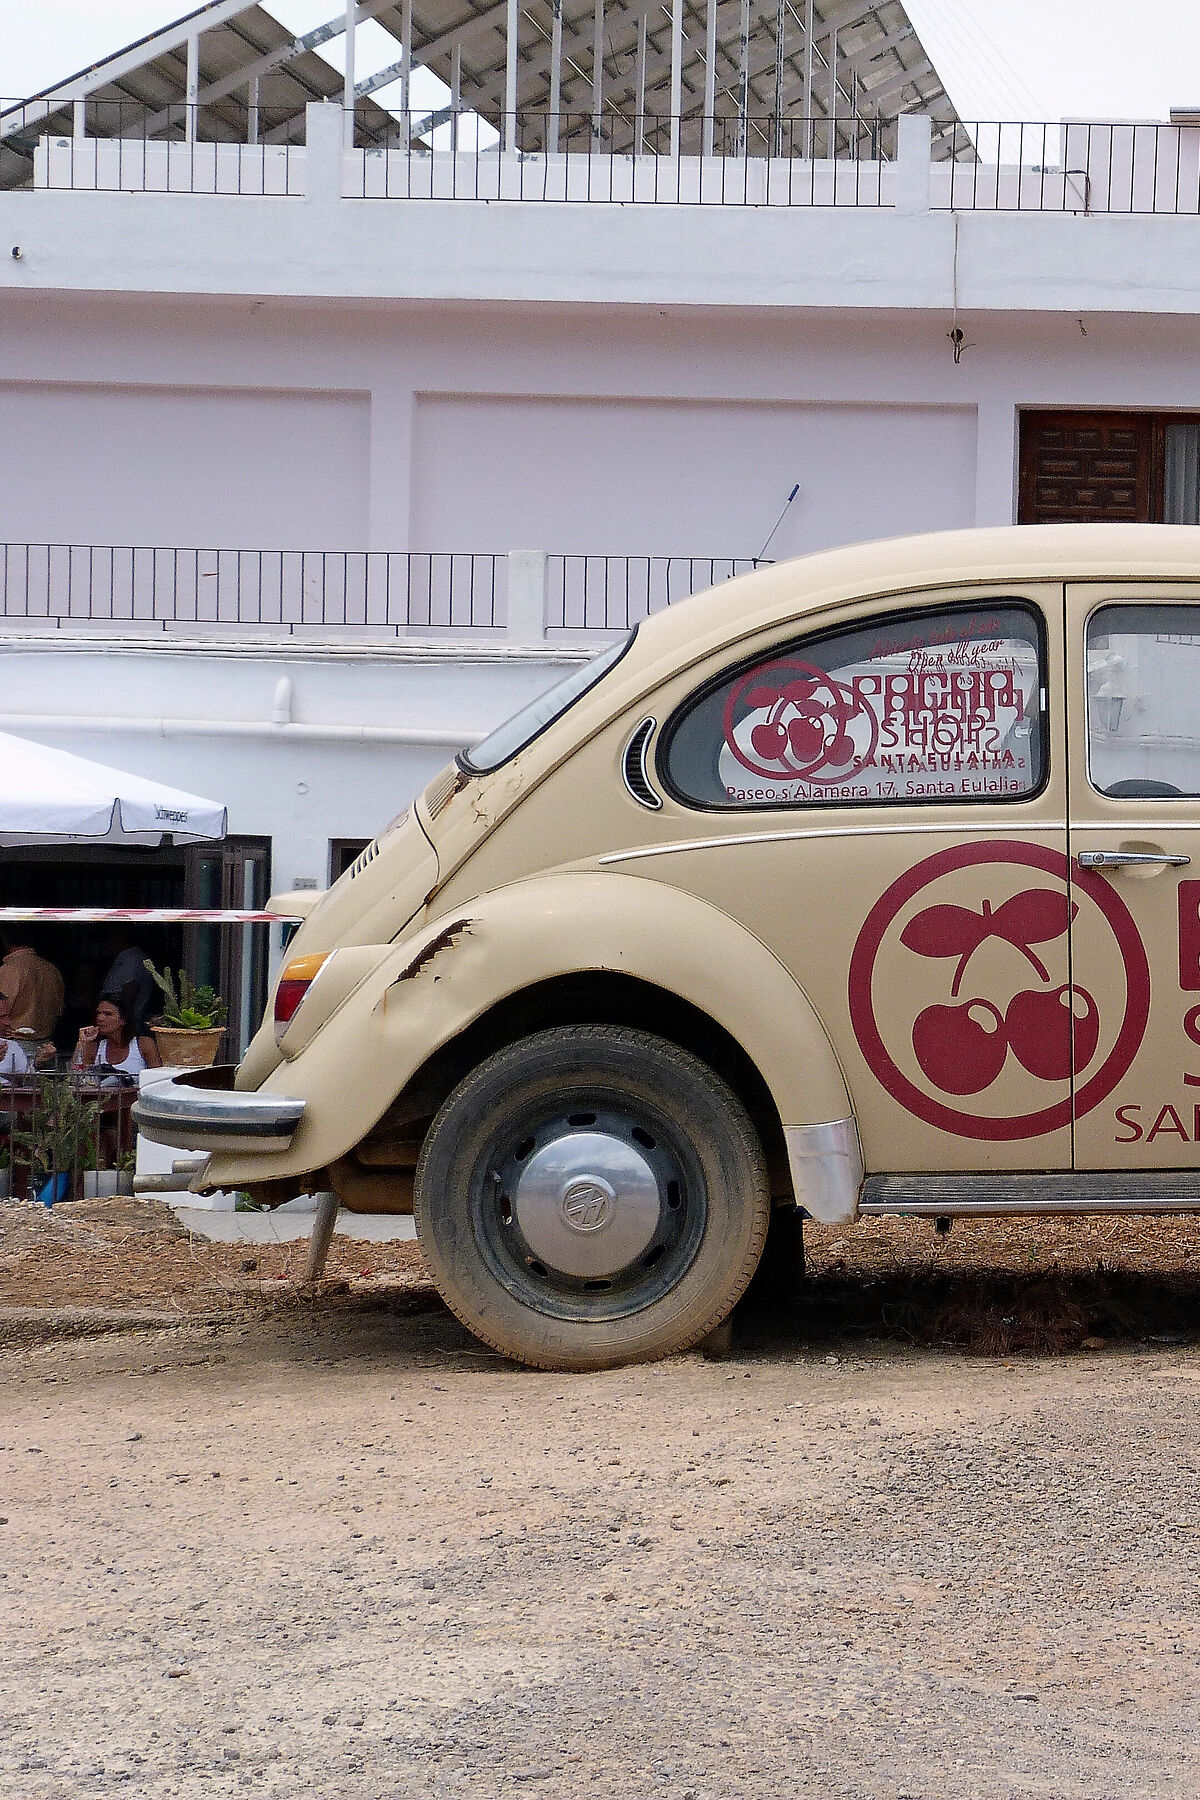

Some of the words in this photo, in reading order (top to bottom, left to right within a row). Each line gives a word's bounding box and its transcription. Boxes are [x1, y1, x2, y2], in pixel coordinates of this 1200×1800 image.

[908, 649, 943, 673] Open
[948, 640, 970, 663] all
[972, 640, 1004, 663] year
[881, 714, 986, 748] SHOP
[852, 753, 920, 768] SANTA
[927, 749, 1014, 765] EULALIA
[727, 786, 776, 800] Paseo
[876, 781, 899, 798] 17,
[906, 780, 955, 795] Santa
[961, 777, 1019, 793] Eulalia
